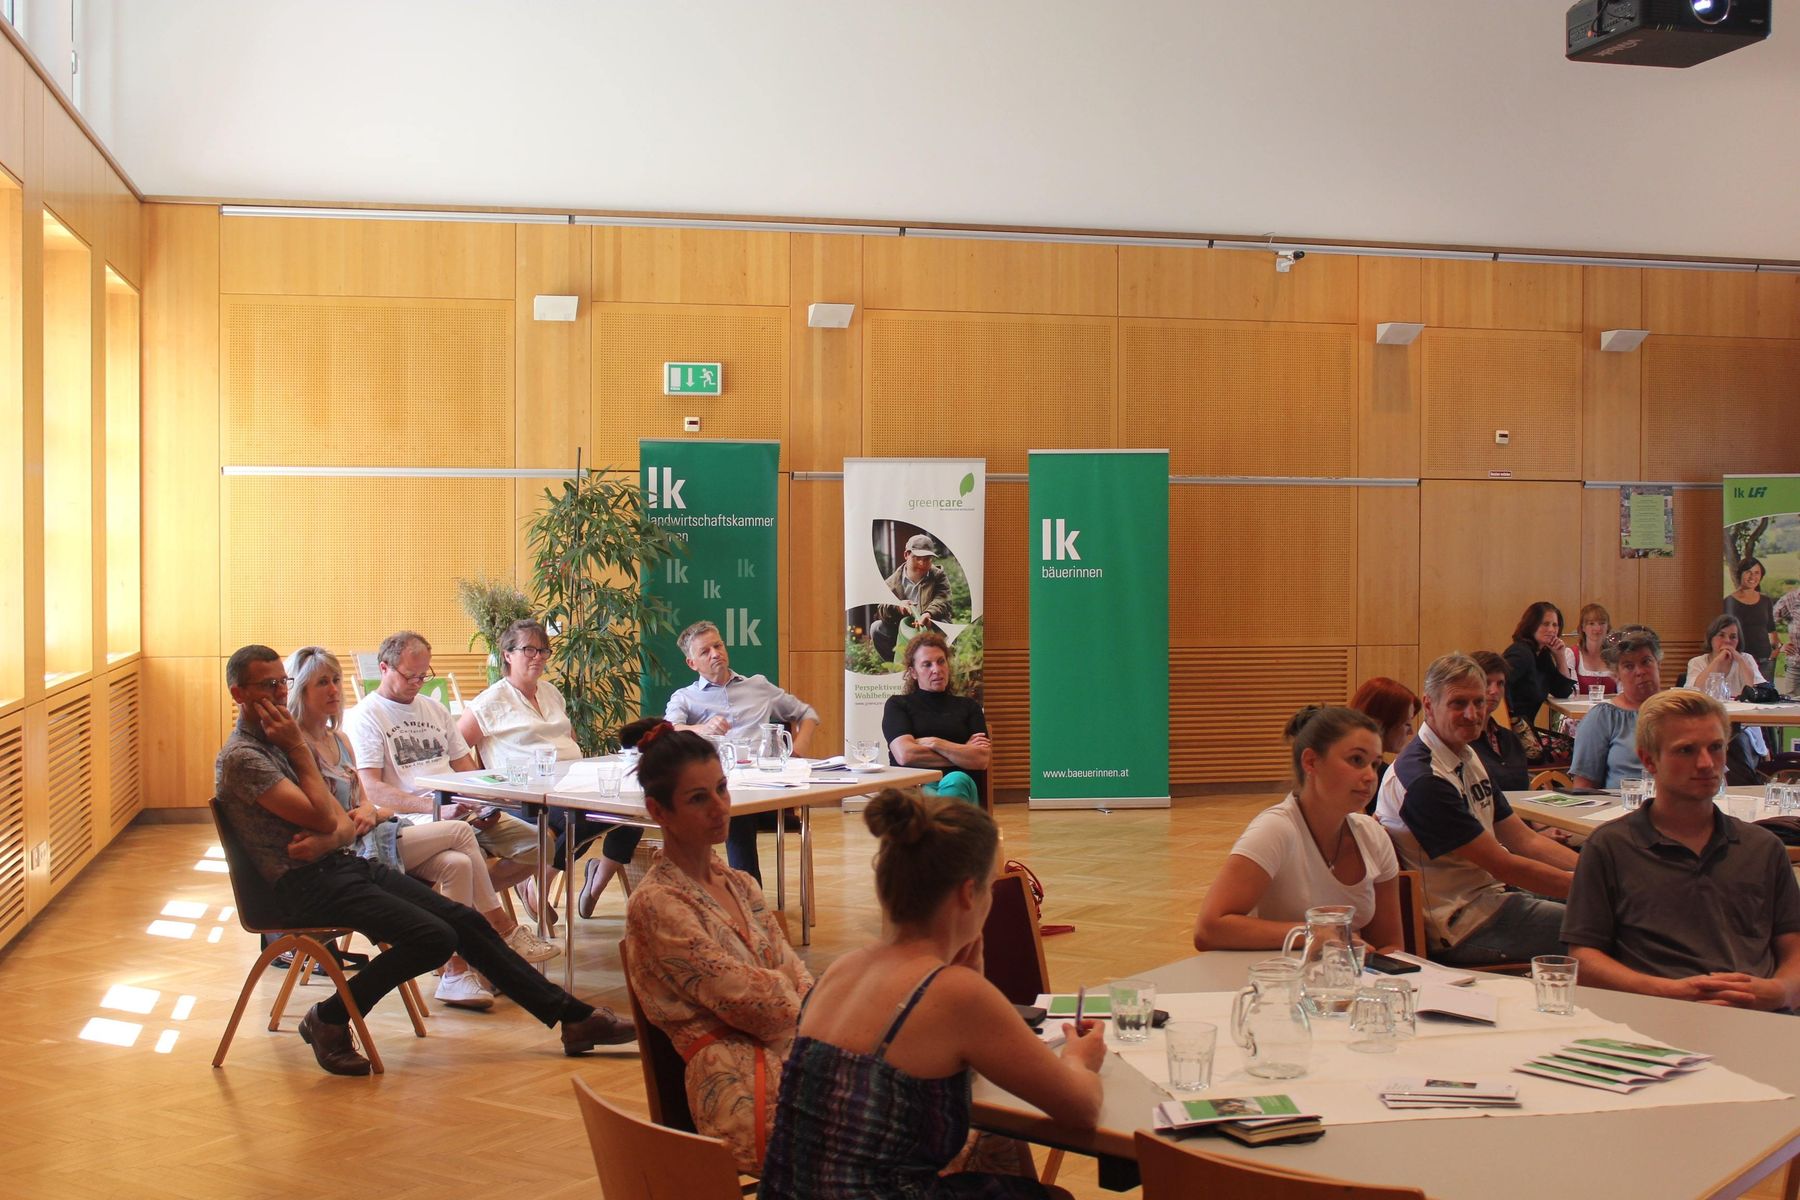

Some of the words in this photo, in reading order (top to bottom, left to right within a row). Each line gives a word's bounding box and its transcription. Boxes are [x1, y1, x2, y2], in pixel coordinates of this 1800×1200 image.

[648, 467, 687, 509] lk
[1734, 487, 1745, 498] lk
[908, 499, 963, 511] greencare
[647, 513, 774, 527] landwirtschaftskammer
[1042, 519, 1081, 560] lk
[667, 559, 688, 583] lk
[738, 559, 755, 577] lk
[1042, 565, 1103, 578] bäuerinnen
[704, 580, 721, 598] lk
[726, 608, 762, 646] lk
[854, 684, 902, 692] Perspektiven
[1043, 768, 1129, 778] www.baeuerinnen.at
